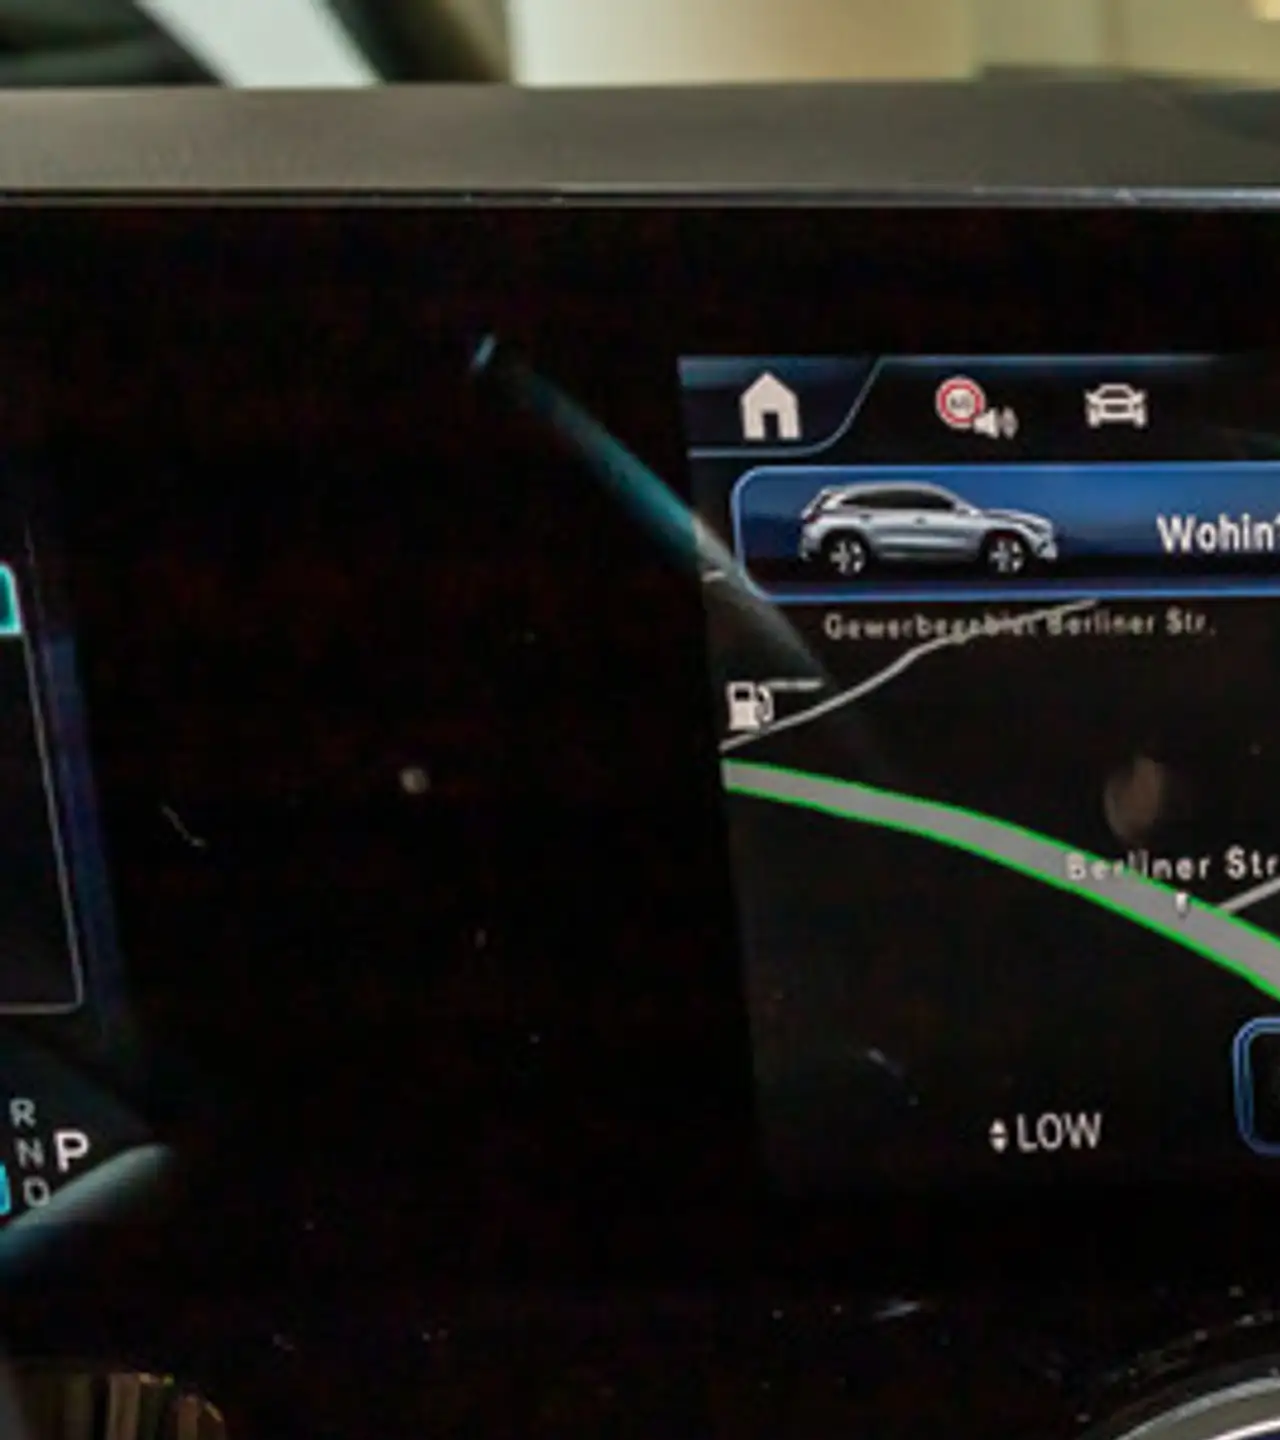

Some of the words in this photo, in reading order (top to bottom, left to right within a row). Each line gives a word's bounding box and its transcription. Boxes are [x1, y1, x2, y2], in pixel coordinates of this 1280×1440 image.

[1065, 848, 1212, 882] Berliner
[9, 1097, 37, 1128] R
[1016, 1113, 1103, 1153] LOW
[16, 1137, 44, 1169] N
[54, 1129, 90, 1173] P
